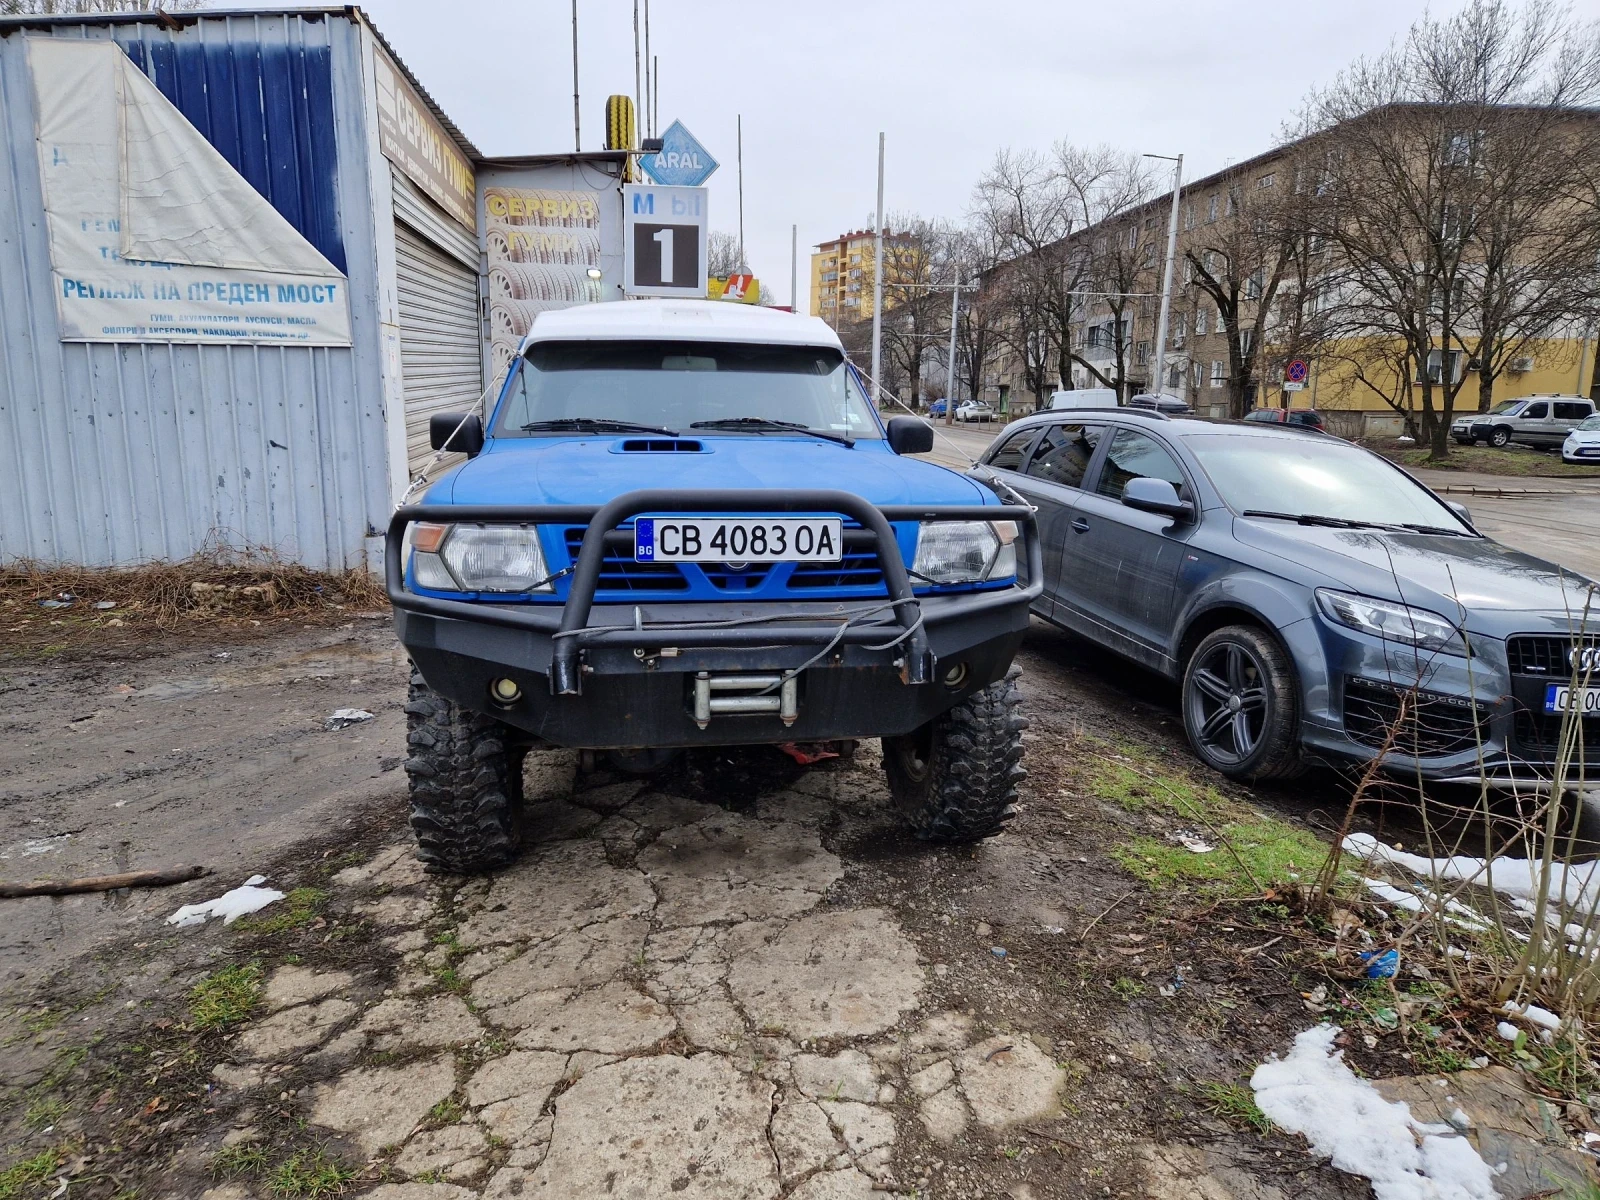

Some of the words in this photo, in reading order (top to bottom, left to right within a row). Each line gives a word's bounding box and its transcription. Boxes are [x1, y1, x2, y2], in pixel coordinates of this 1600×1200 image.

[396, 87, 442, 174] СЕРВИЗ
[443, 141, 467, 200] ГУМИ
[654, 151, 703, 169] ARAL
[489, 196, 595, 220] СЕРВИЗ
[508, 232, 579, 252] ГУМИ
[653, 228, 674, 283] 1
[153, 281, 181, 301] НА
[187, 282, 270, 305] ПРЕДЕН
[276, 283, 336, 304] МОСТ
[102, 326, 138, 335] ФИЛТРИ
[287, 317, 317, 325] МАСЛА
[638, 545, 653, 555] BG
[659, 525, 702, 555] CB
[709, 525, 787, 555] 4083
